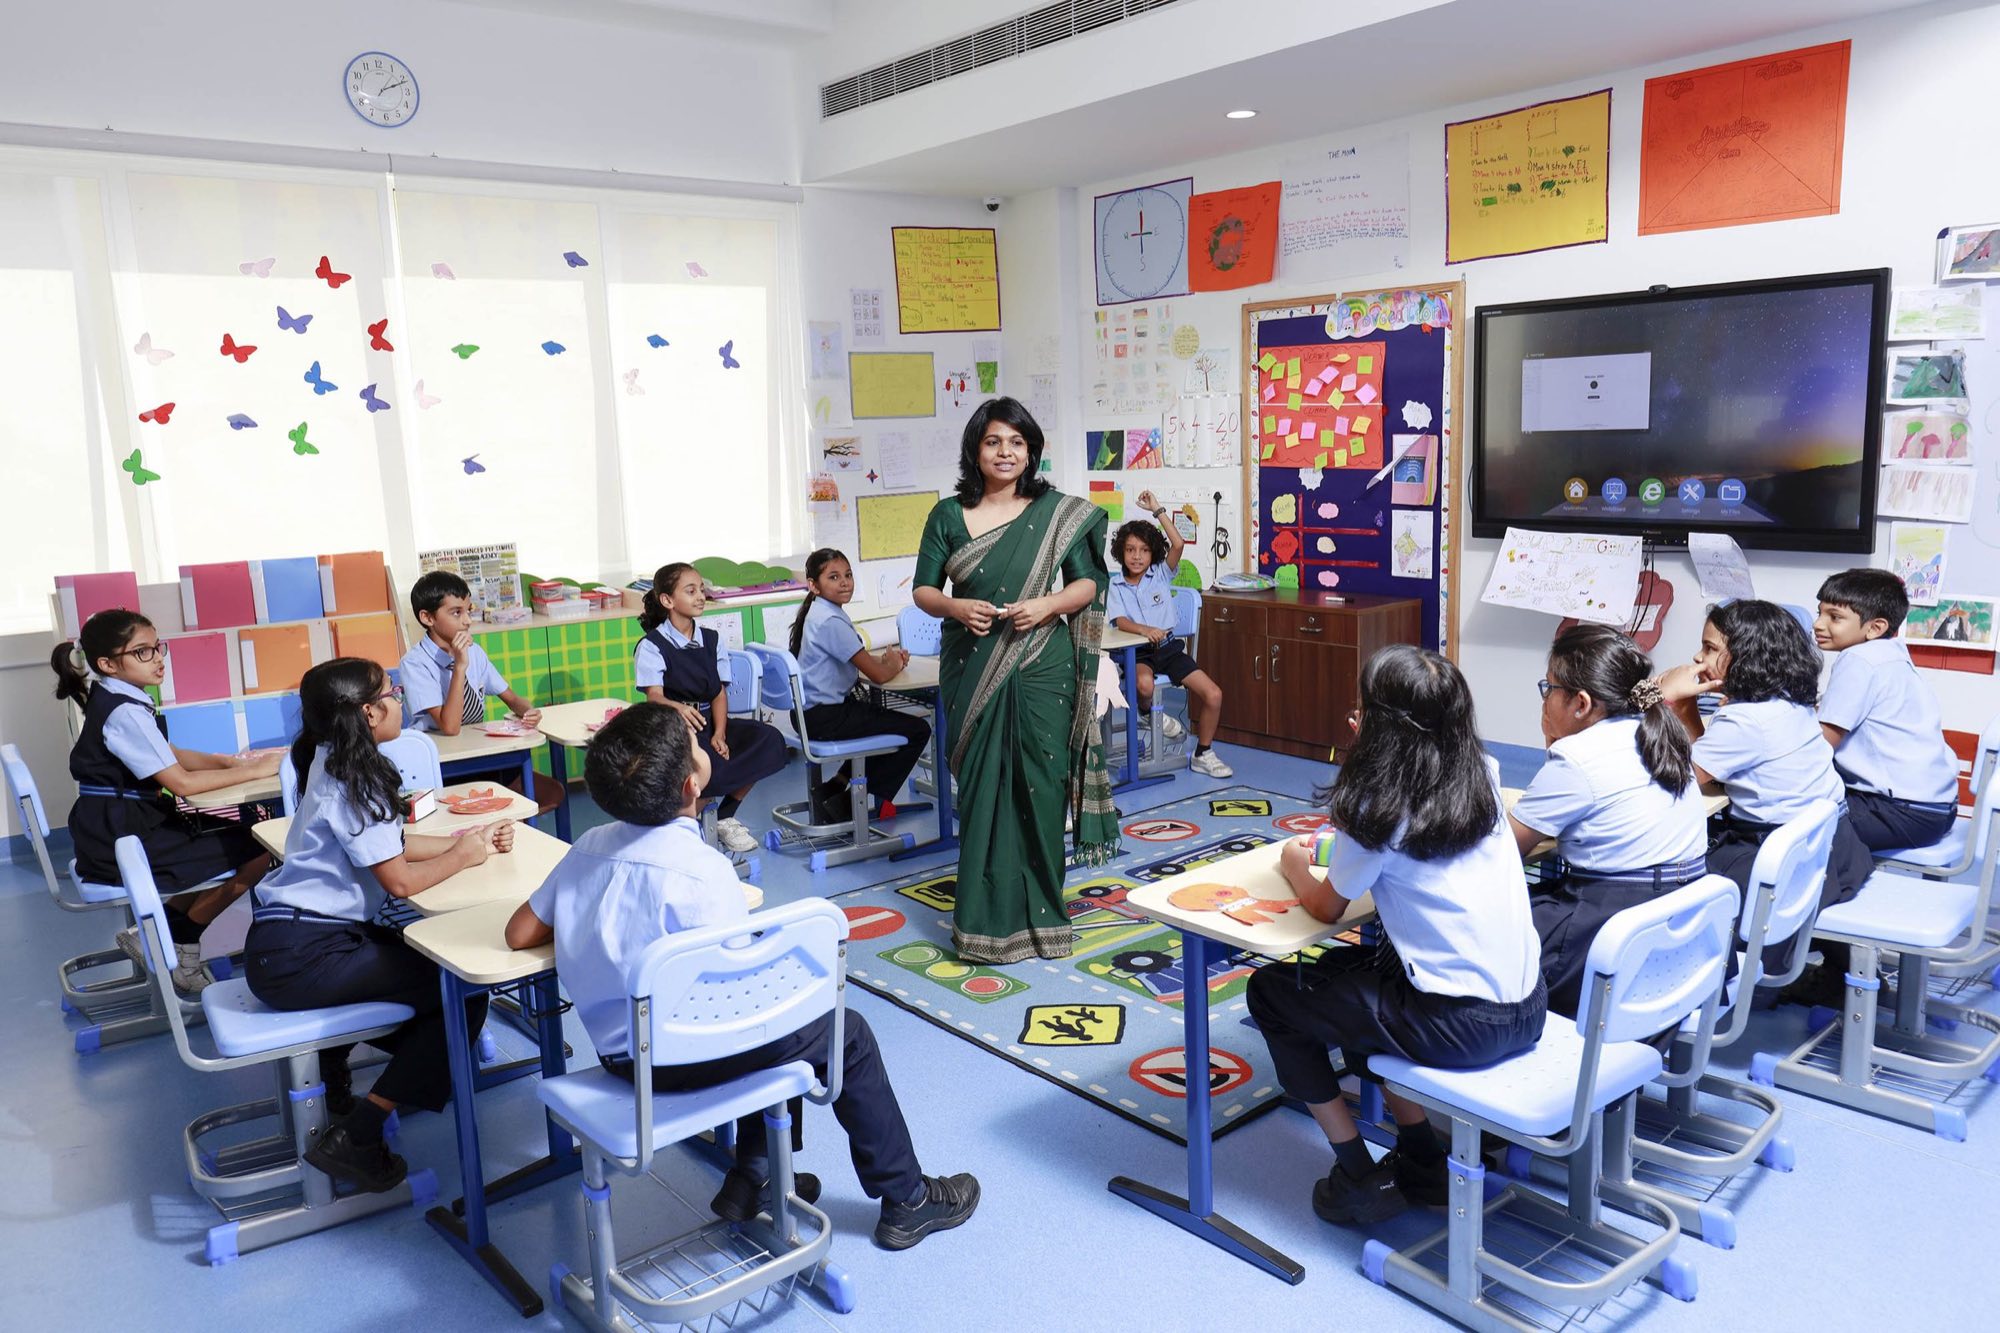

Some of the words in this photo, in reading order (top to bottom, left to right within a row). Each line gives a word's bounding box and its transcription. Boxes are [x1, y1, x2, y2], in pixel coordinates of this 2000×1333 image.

[363, 62, 369, 71] 11
[375, 60, 383, 69] 12
[354, 71, 362, 80] 10
[353, 84, 359, 93] 9
[404, 88, 411, 96] 3
[359, 97, 365, 106] 8
[404, 100, 409, 109] 4
[370, 108, 374, 117] 7
[383, 113, 389, 121] 6
[395, 110, 401, 118] 5
[1328, 151, 1340, 160] THE
[1168, 416, 1177, 435] 5
[1192, 413, 1201, 436] 4
[1216, 412, 1239, 433] 20
[1681, 507, 1701, 515] Settings
[419, 552, 441, 560] MAKING
[455, 547, 483, 556] ENHANCED
